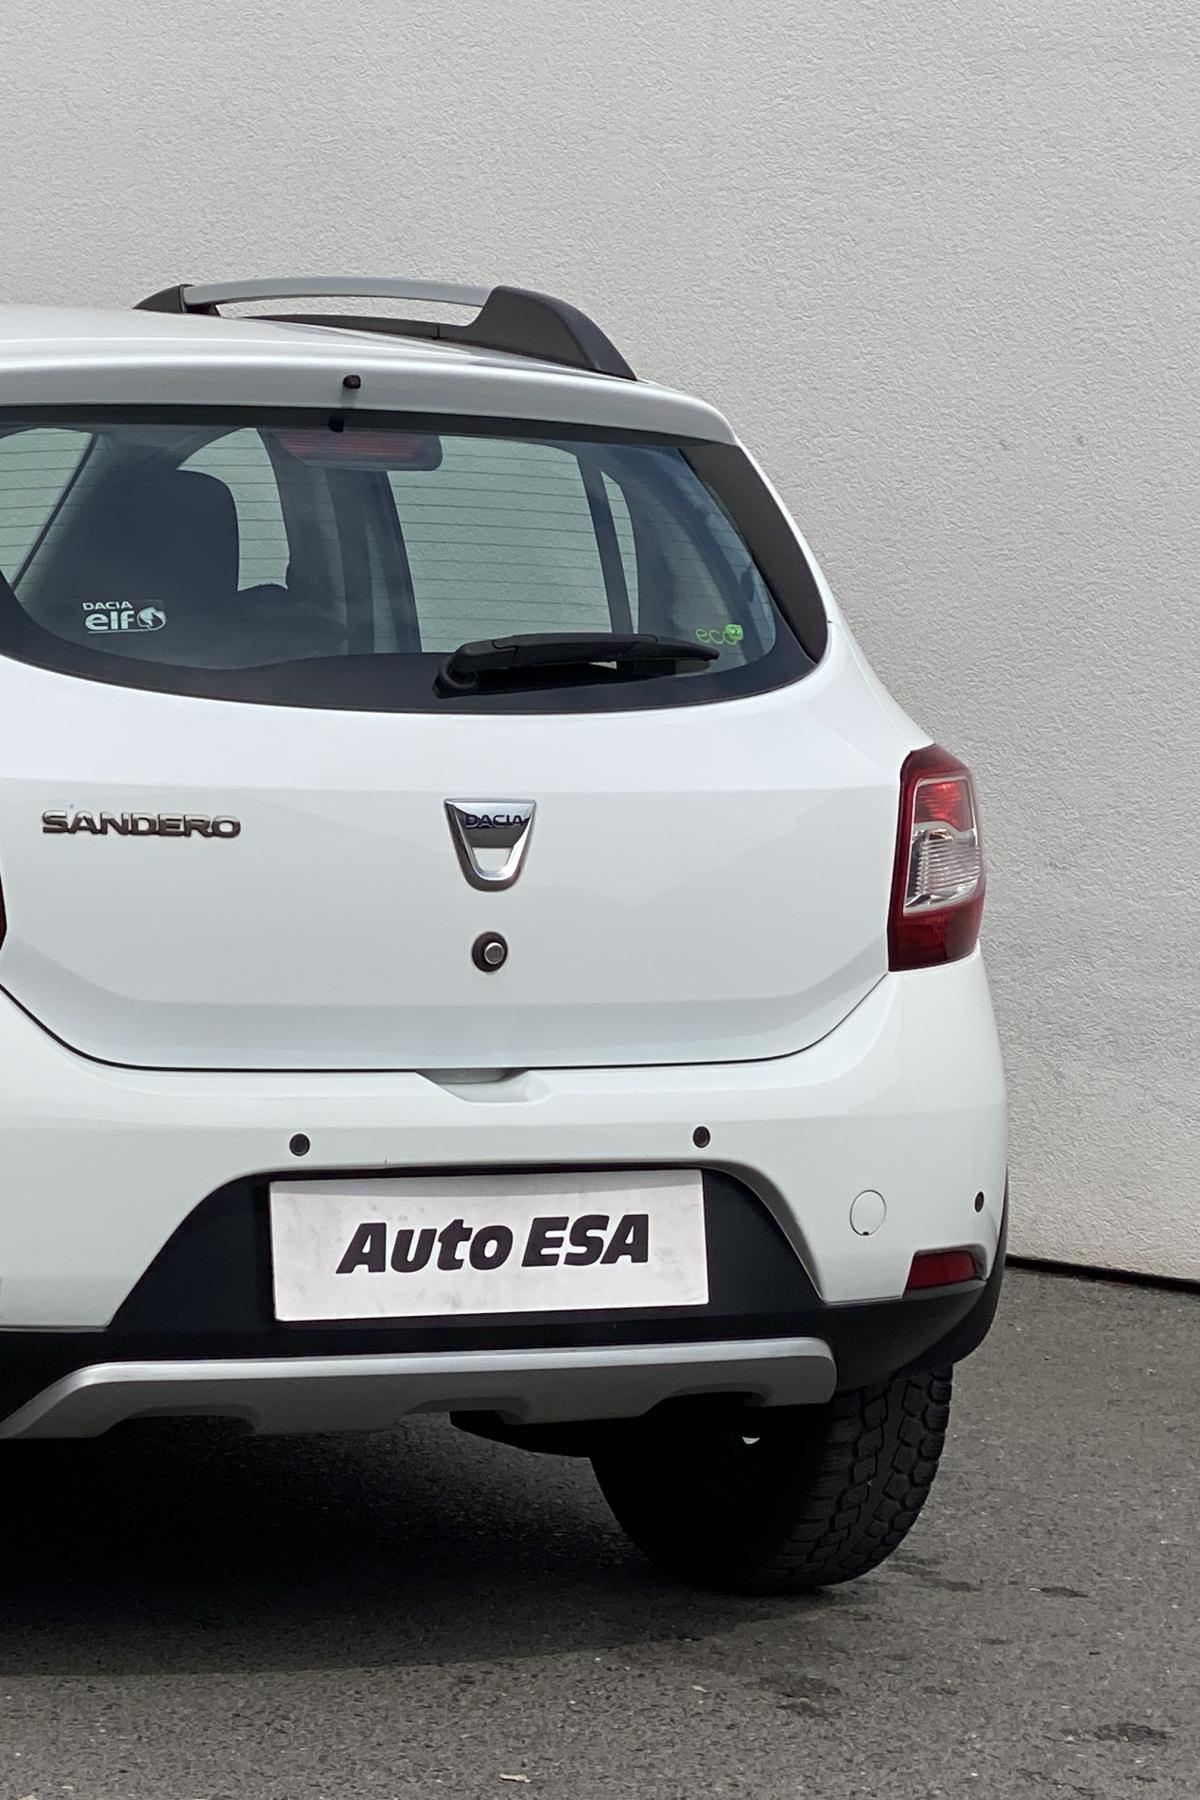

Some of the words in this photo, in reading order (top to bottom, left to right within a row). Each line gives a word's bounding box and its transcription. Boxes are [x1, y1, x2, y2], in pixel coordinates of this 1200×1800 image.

[82, 601, 133, 611] DACIA
[85, 610, 134, 630] elf
[42, 810, 241, 838] SANDERO
[464, 814, 523, 828] DACIA
[336, 1219, 513, 1274] Auto
[521, 1214, 649, 1267] ESA
